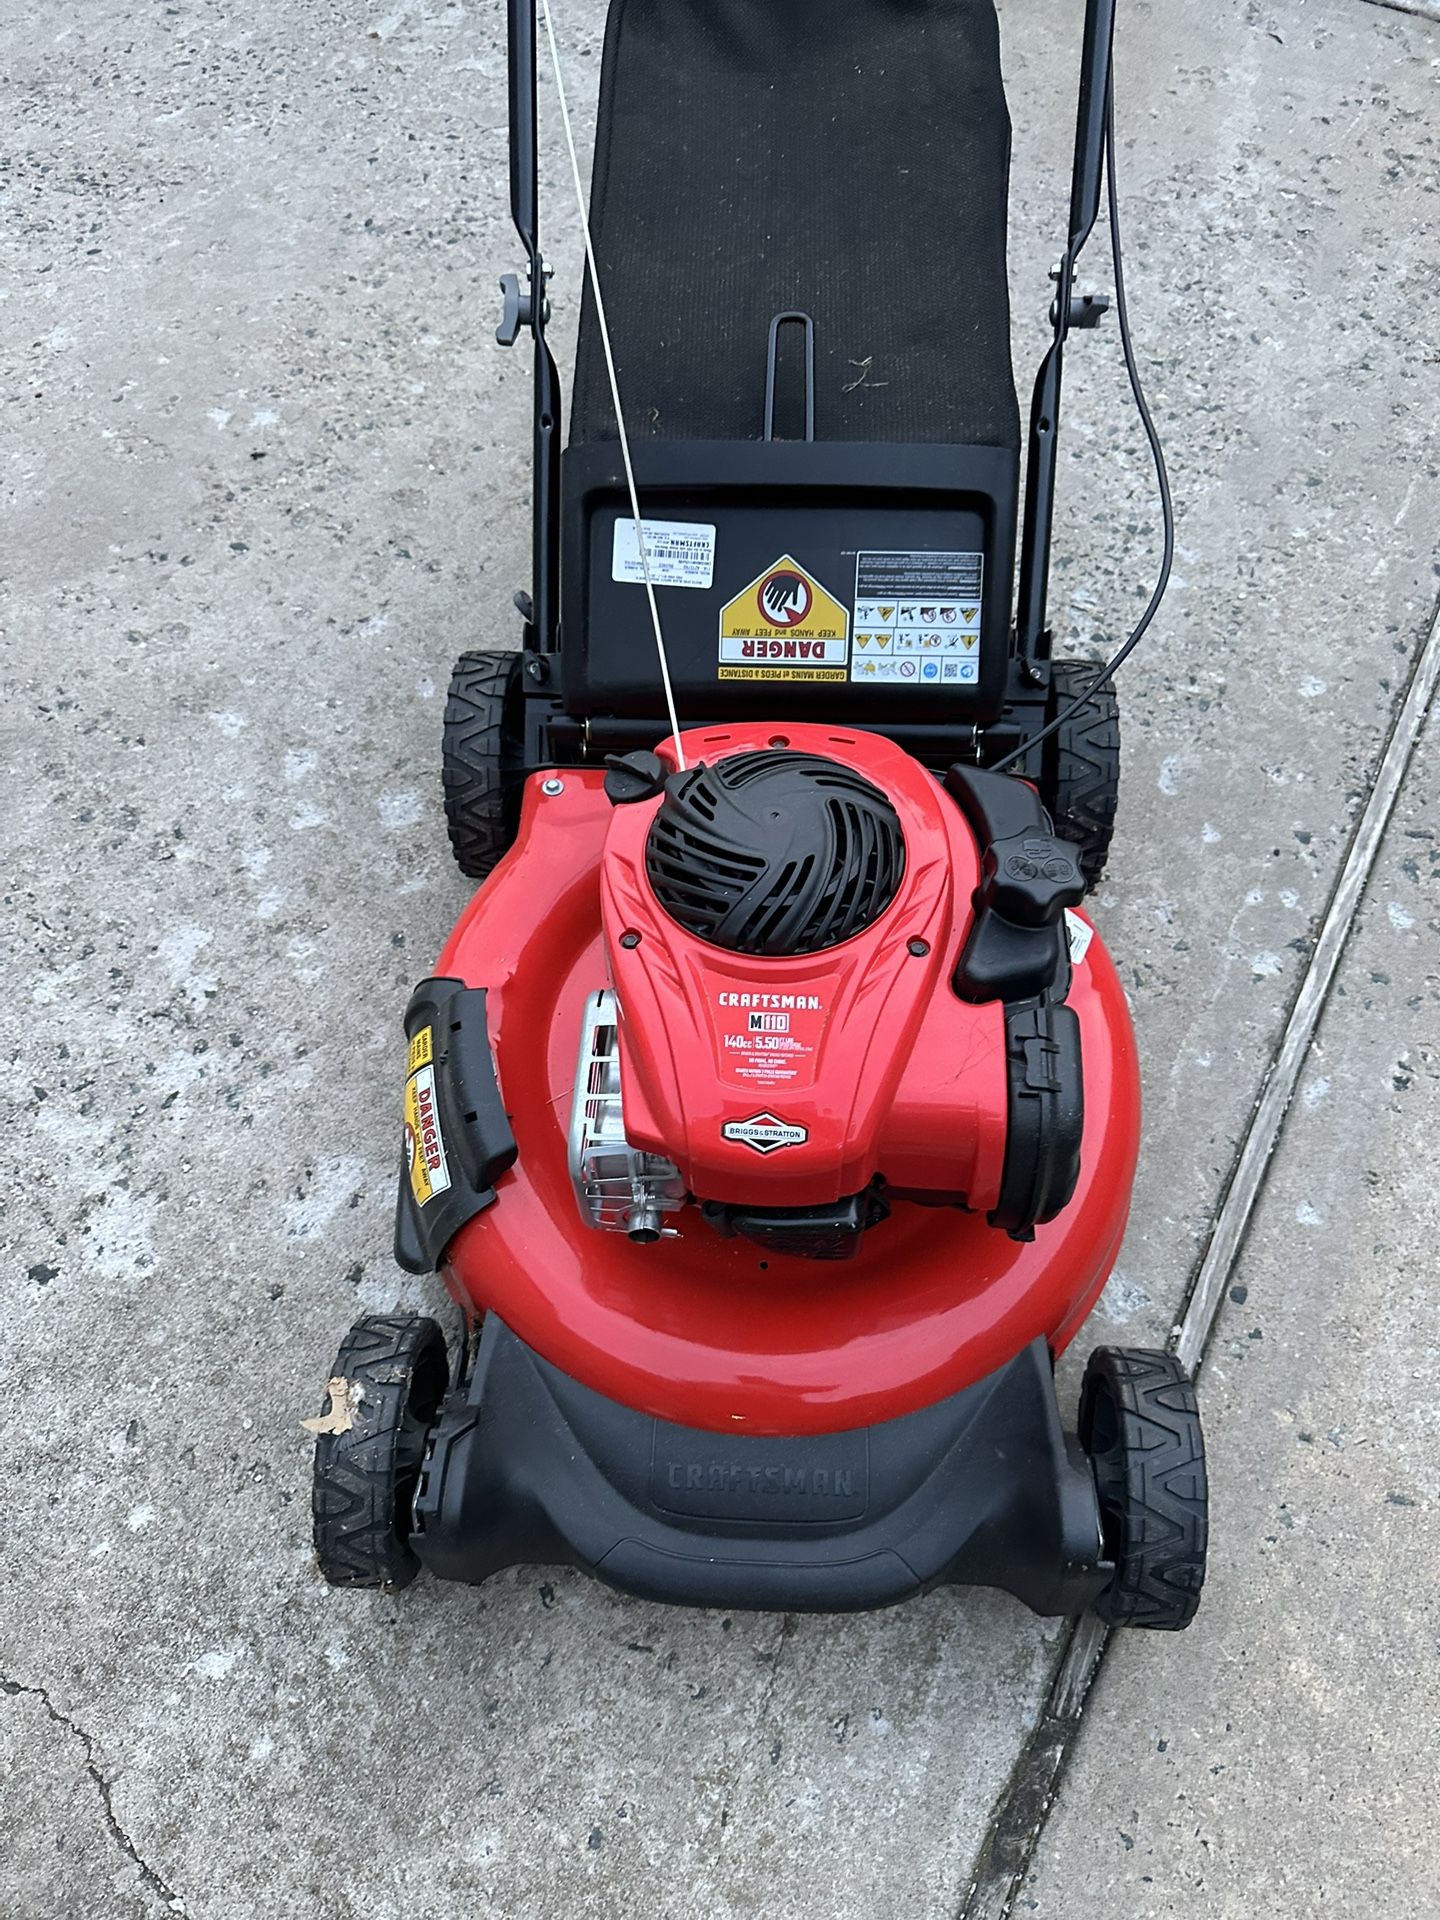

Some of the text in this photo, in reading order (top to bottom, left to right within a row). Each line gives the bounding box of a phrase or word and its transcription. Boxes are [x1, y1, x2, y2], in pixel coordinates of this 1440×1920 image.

[670, 540, 709, 548] CRAFTSMAN
[731, 627, 836, 637] KEEP HANDS and FEET AWAY
[741, 640, 825, 659] DANGER
[720, 668, 753, 678] DISTANCE
[761, 669, 781, 678] PIEDS
[783, 670, 790, 679] et
[791, 670, 814, 679] MAINS
[816, 671, 845, 680] GARDER
[750, 1014, 787, 1031] M110
[724, 1034, 753, 1049] 140cc
[755, 1036, 779, 1050] 5.50
[418, 1087, 442, 1172] DANGER
[421, 1168, 430, 1187] AWAY
[668, 1462, 852, 1497] CRAFTSMAN
